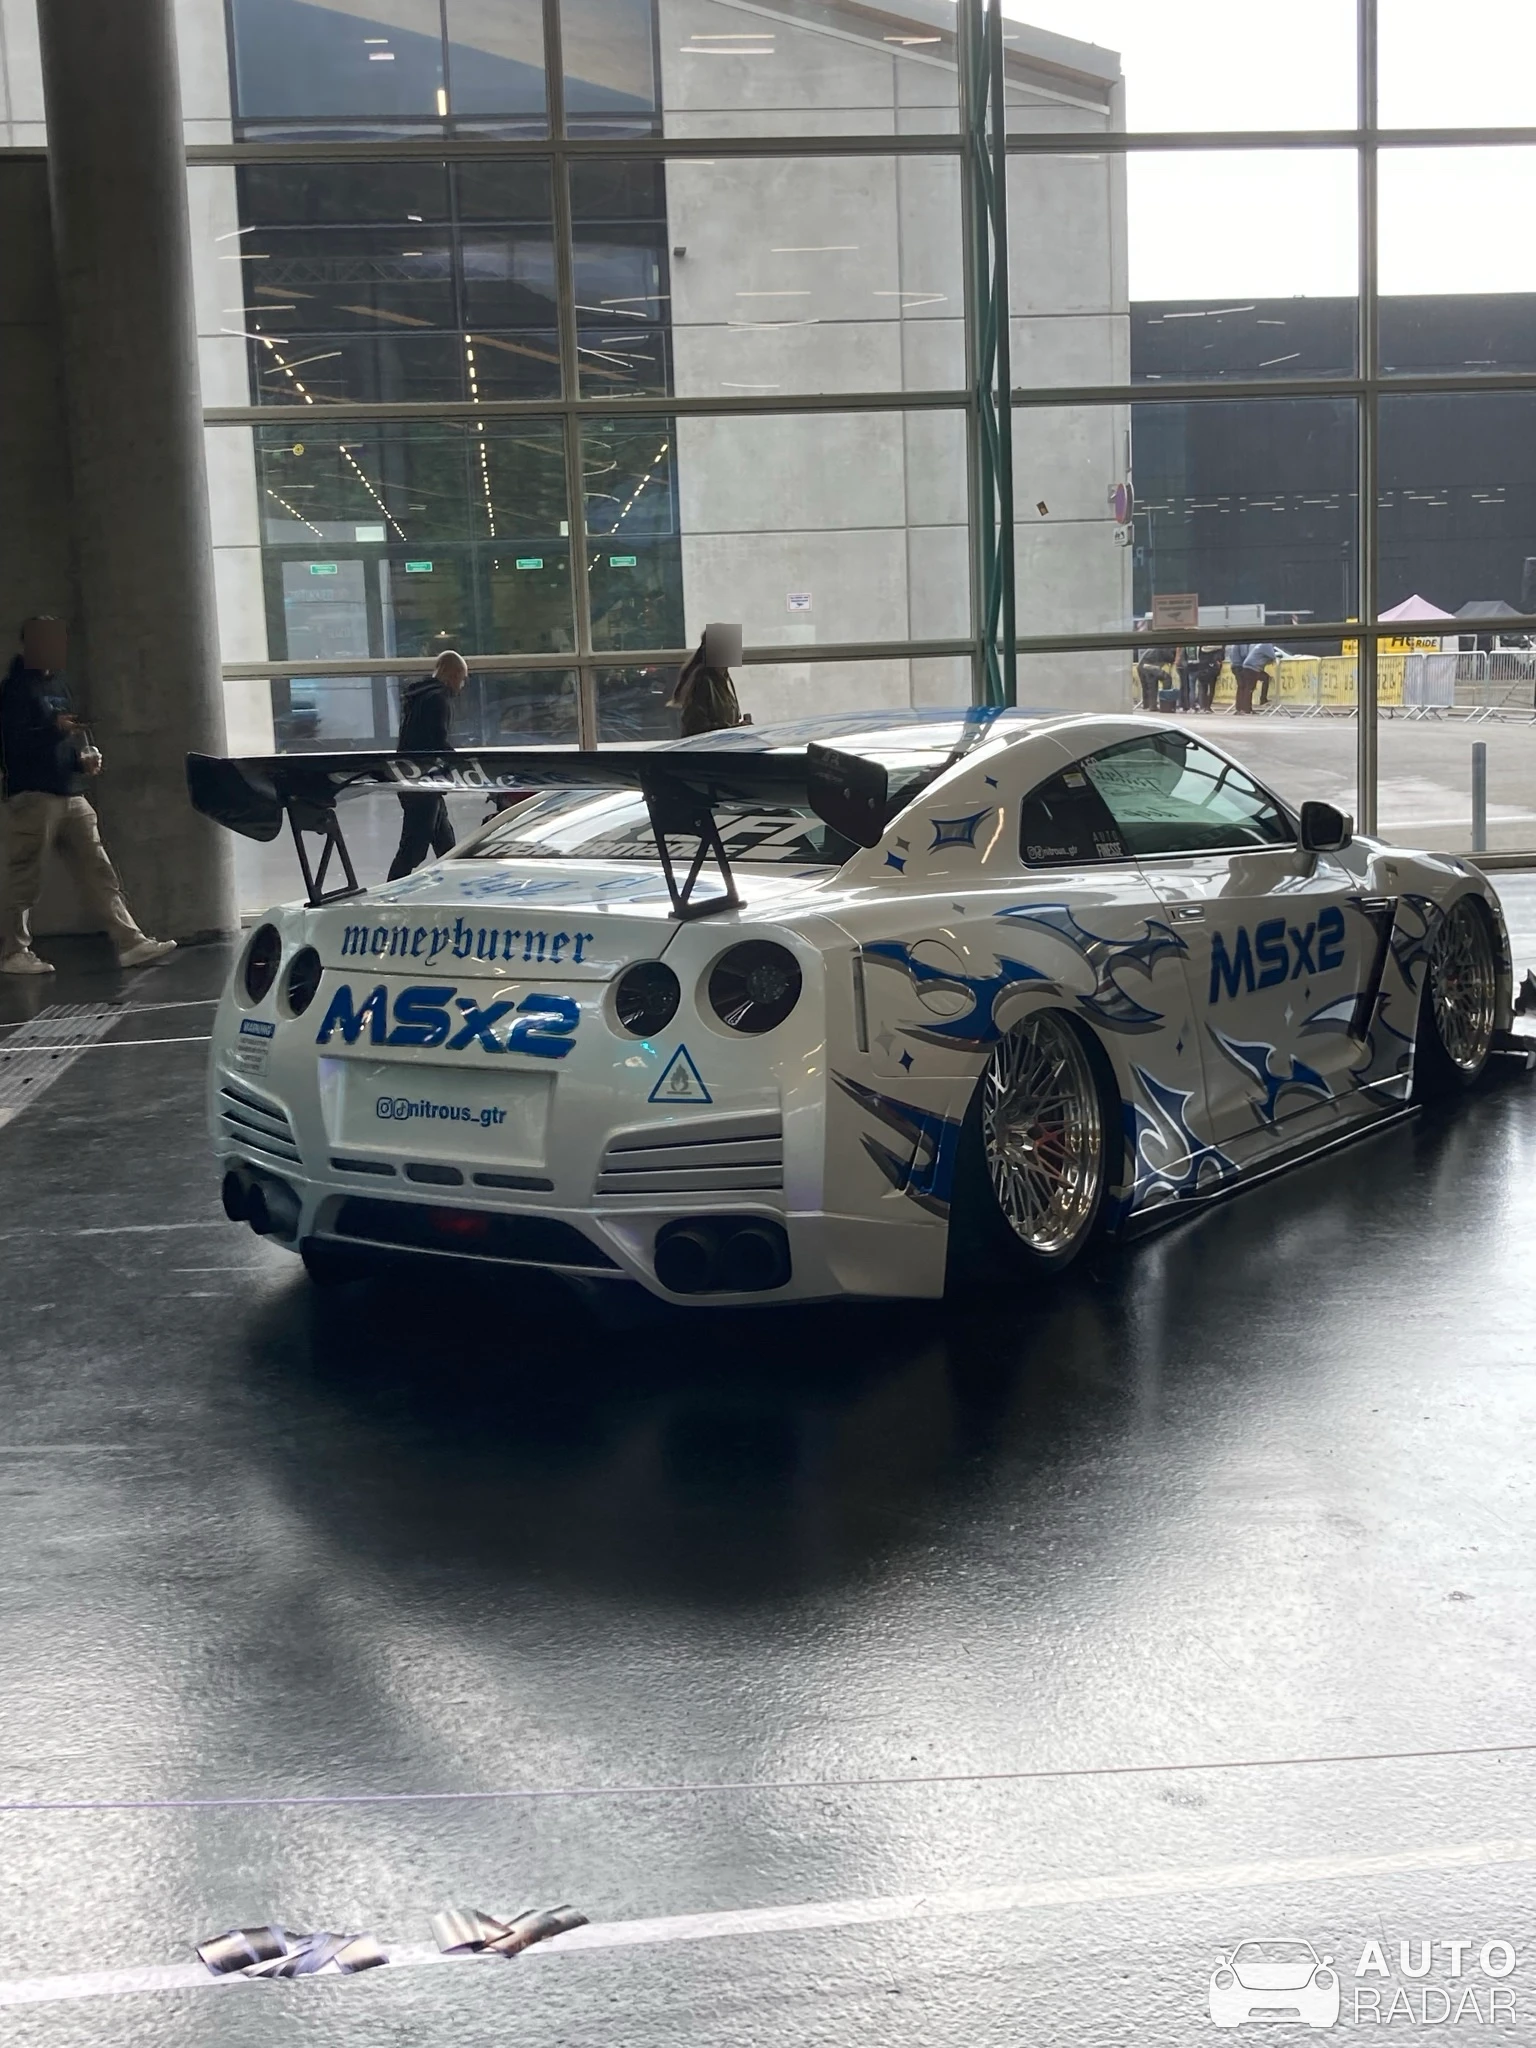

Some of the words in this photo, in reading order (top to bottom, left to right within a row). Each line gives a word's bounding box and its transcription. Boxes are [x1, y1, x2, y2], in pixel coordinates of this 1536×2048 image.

[1416, 639, 1437, 648] RIDE
[490, 842, 748, 859] PERORMANCE
[1096, 842, 1123, 858] FINESSE
[341, 917, 594, 966] moneyburner
[409, 1100, 507, 1127] nitrous_gtr
